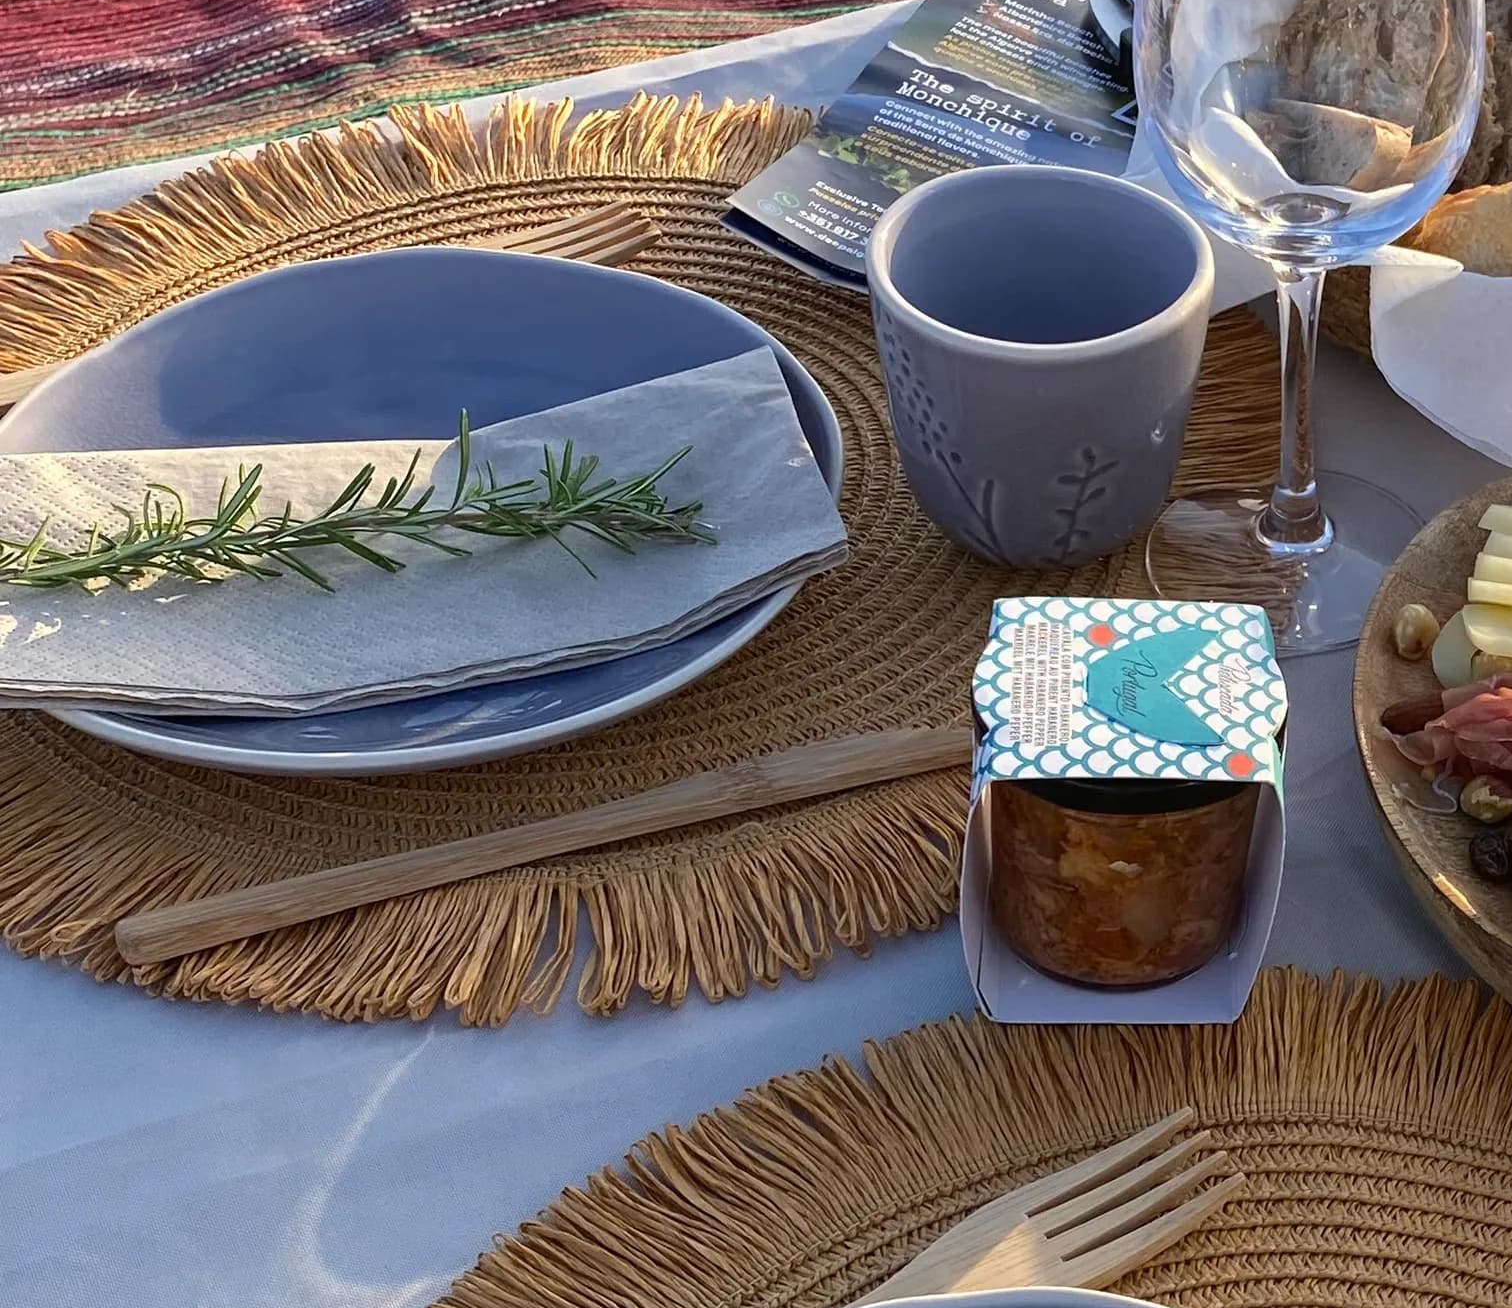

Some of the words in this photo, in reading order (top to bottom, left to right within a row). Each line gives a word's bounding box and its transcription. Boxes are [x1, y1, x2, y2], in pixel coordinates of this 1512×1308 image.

[962, 16, 983, 27] The
[982, 25, 1013, 39] most
[968, 26, 988, 37] the
[988, 35, 1033, 55] Algarve
[1034, 53, 1059, 66] with
[979, 39, 1025, 61] cheeses
[1026, 58, 1051, 70] and
[896, 81, 1032, 141] Monchique
[910, 68, 955, 94] The
[966, 94, 1056, 132] spirit
[1070, 131, 1102, 148] of
[873, 115, 938, 142] traditional
[939, 137, 981, 159] flavors.
[879, 108, 894, 117] of
[893, 110, 914, 123] the
[914, 119, 946, 136] Serra
[947, 131, 964, 143] de
[885, 100, 936, 122] Connect
[937, 115, 962, 132] with
[964, 127, 984, 140] the
[984, 137, 1037, 162] amazing
[815, 180, 869, 207] Exclusive
[808, 200, 840, 220] More
[1037, 622, 1048, 656] MACKEREL
[1013, 660, 1023, 675] MET
[1025, 657, 1035, 670] MIT
[1036, 659, 1047, 677] WITH
[1048, 666, 1059, 677] AU
[1061, 654, 1071, 670] COM
[1010, 677, 1022, 715] HABANERO
[1035, 679, 1046, 717] HABANERO
[1048, 678, 1058, 704] PIMENT
[1112, 649, 1158, 717] Portugal
[1009, 716, 1020, 741] PEPER
[1034, 718, 1045, 747] PEPPER
[1047, 706, 1058, 745] HABANERO
[1059, 704, 1070, 742] HABANERO
